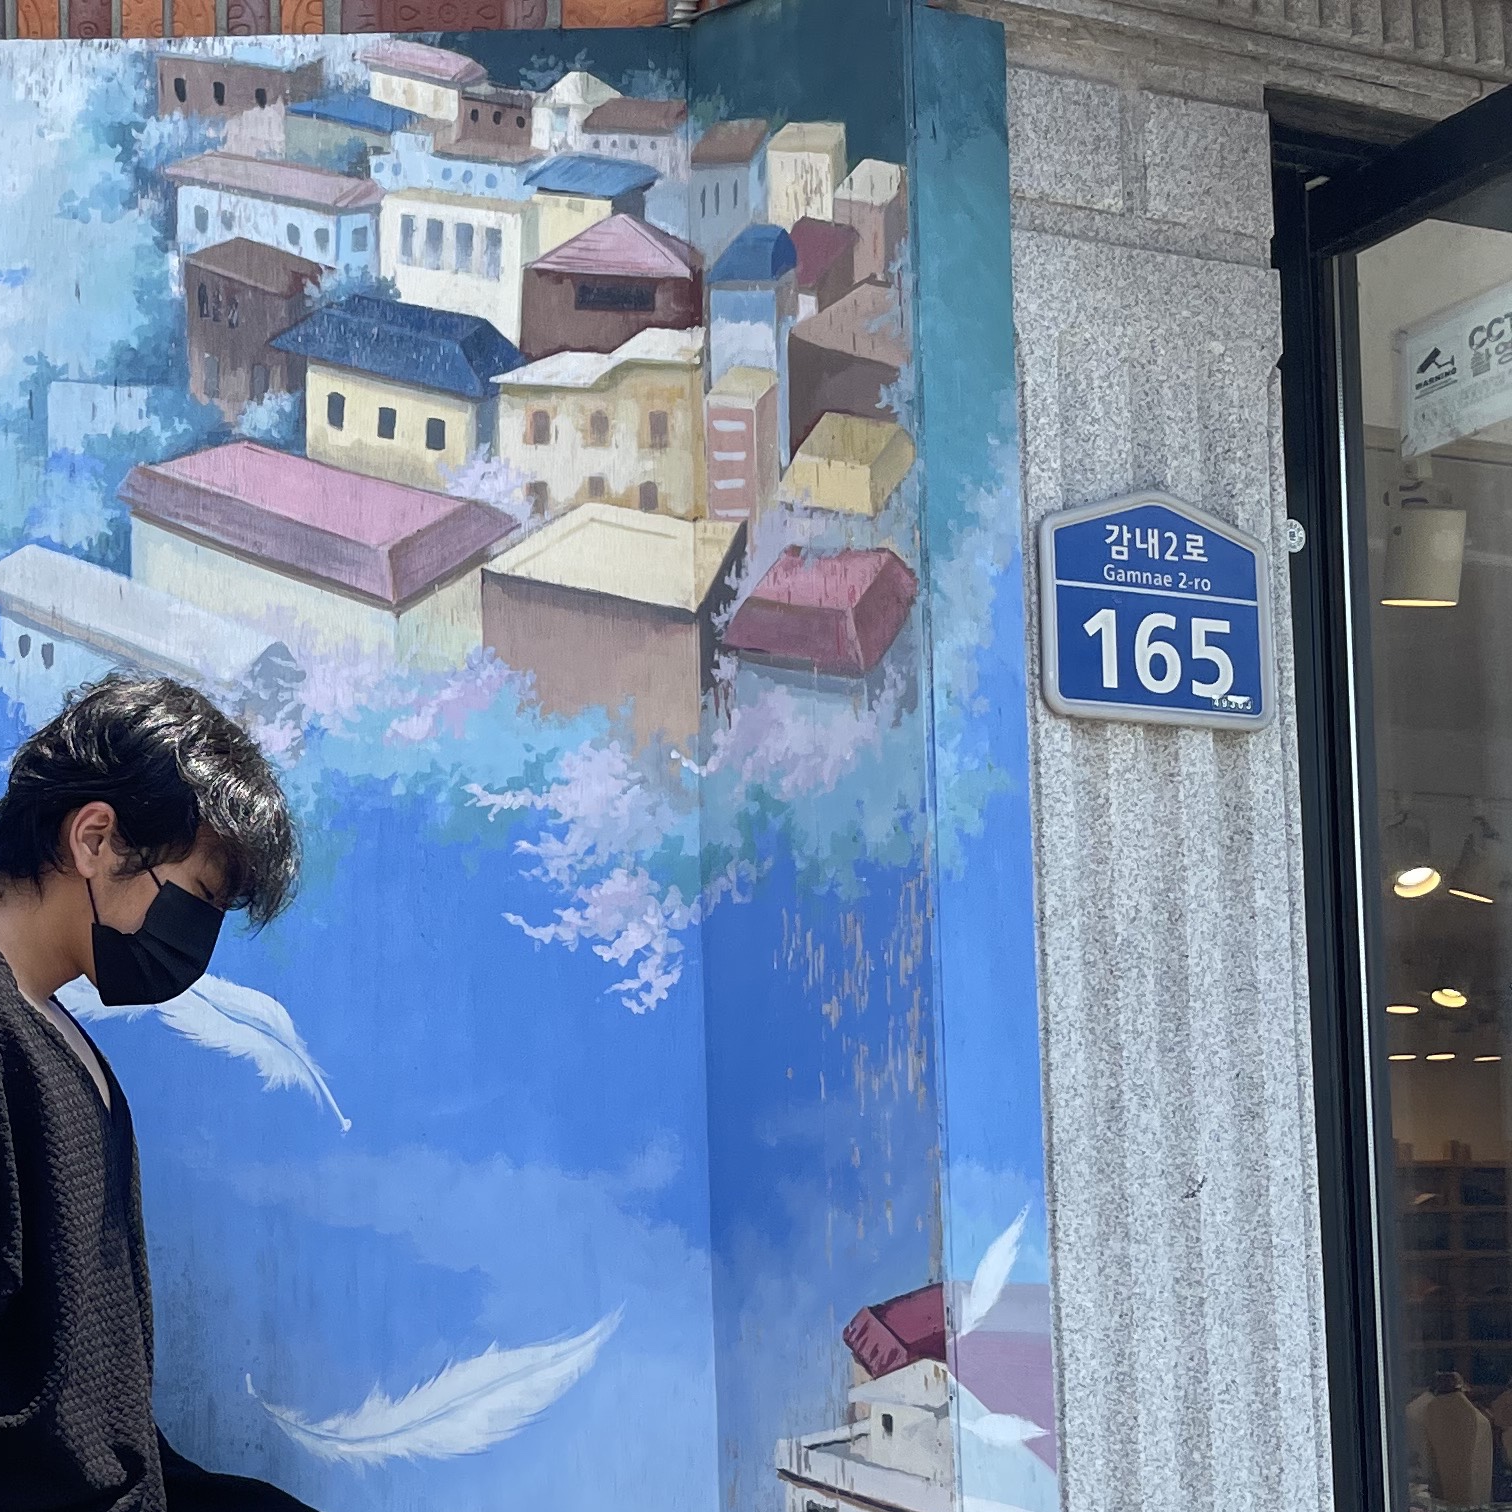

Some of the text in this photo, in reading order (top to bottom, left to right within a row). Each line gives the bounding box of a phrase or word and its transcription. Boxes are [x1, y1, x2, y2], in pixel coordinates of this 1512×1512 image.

[1104, 524, 1209, 562] 감내2로
[1103, 563, 1212, 592] Gamnae 2-ro
[1083, 608, 1234, 699] 165
